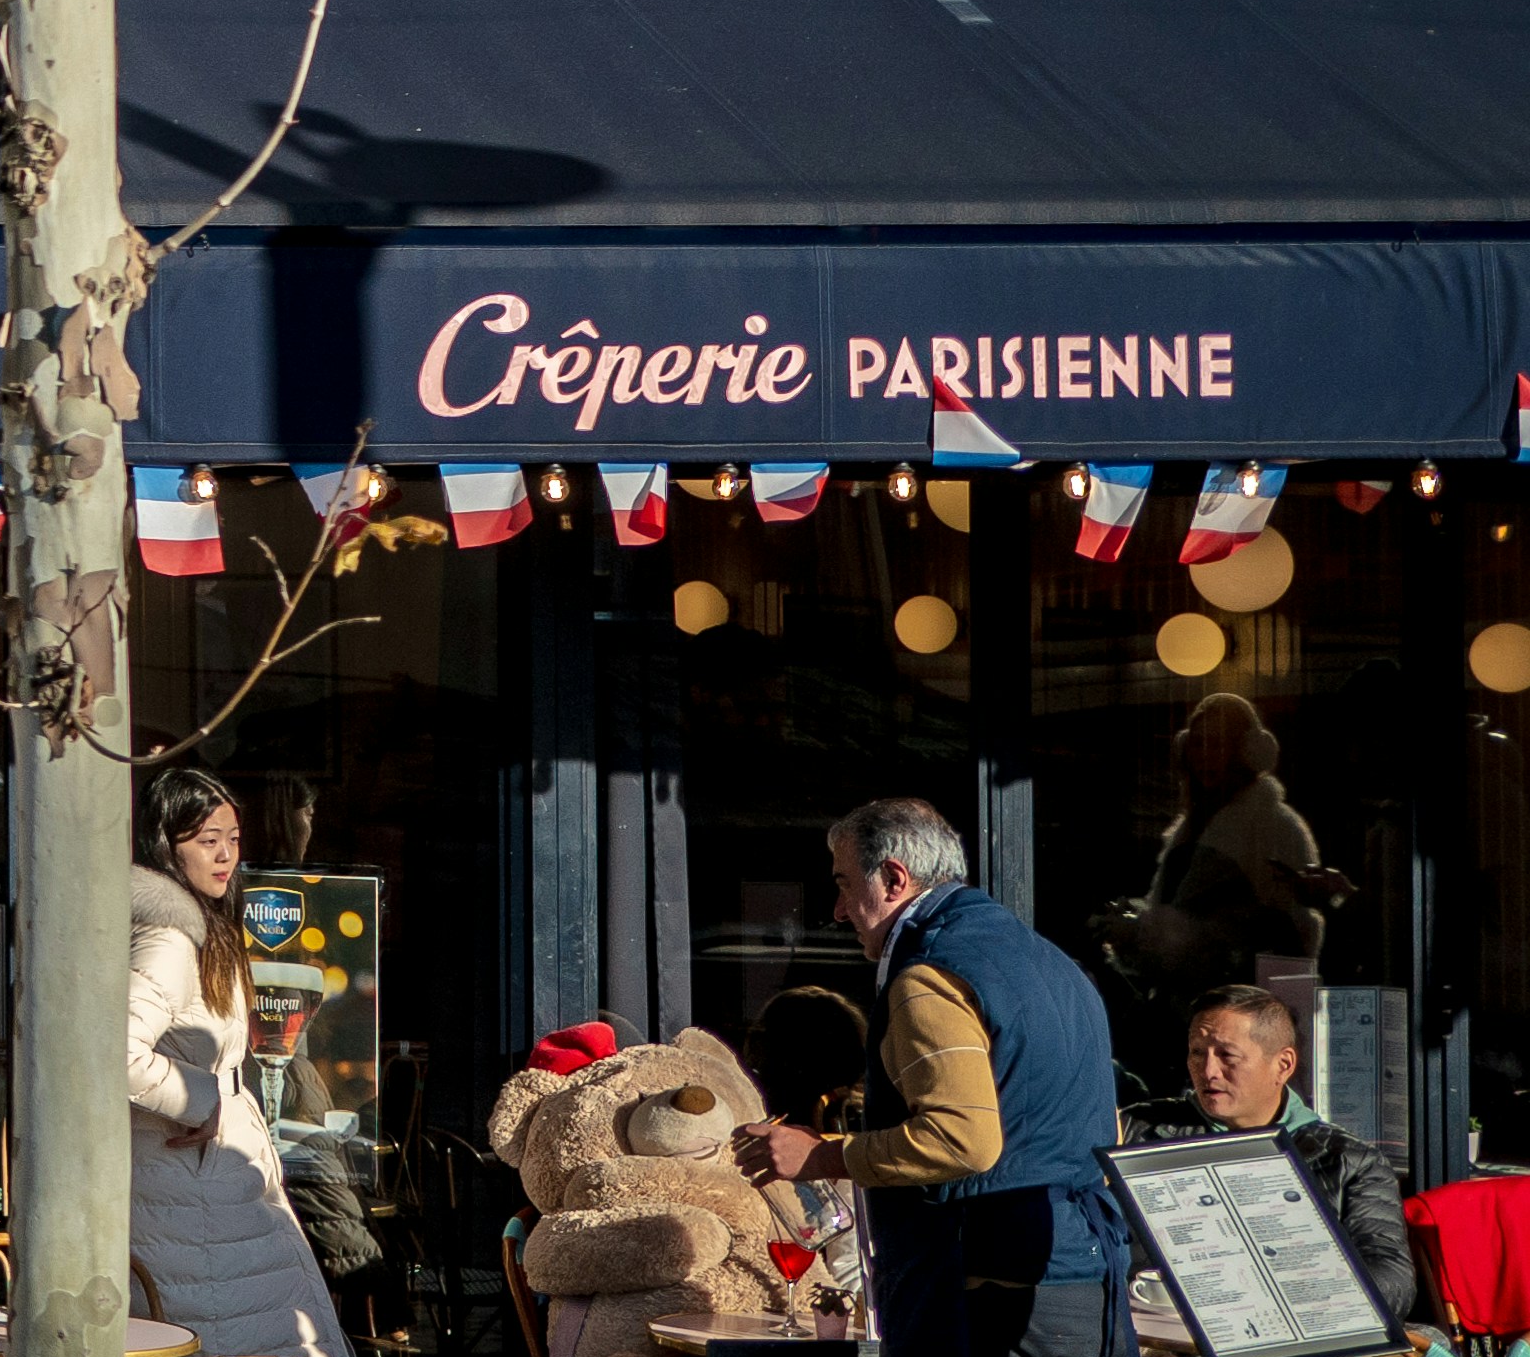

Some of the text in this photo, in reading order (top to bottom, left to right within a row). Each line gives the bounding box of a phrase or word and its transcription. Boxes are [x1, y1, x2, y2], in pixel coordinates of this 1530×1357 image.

[418, 293, 1235, 431] Crêperie PARISIENNE
[244, 902, 301, 924] Affligem
